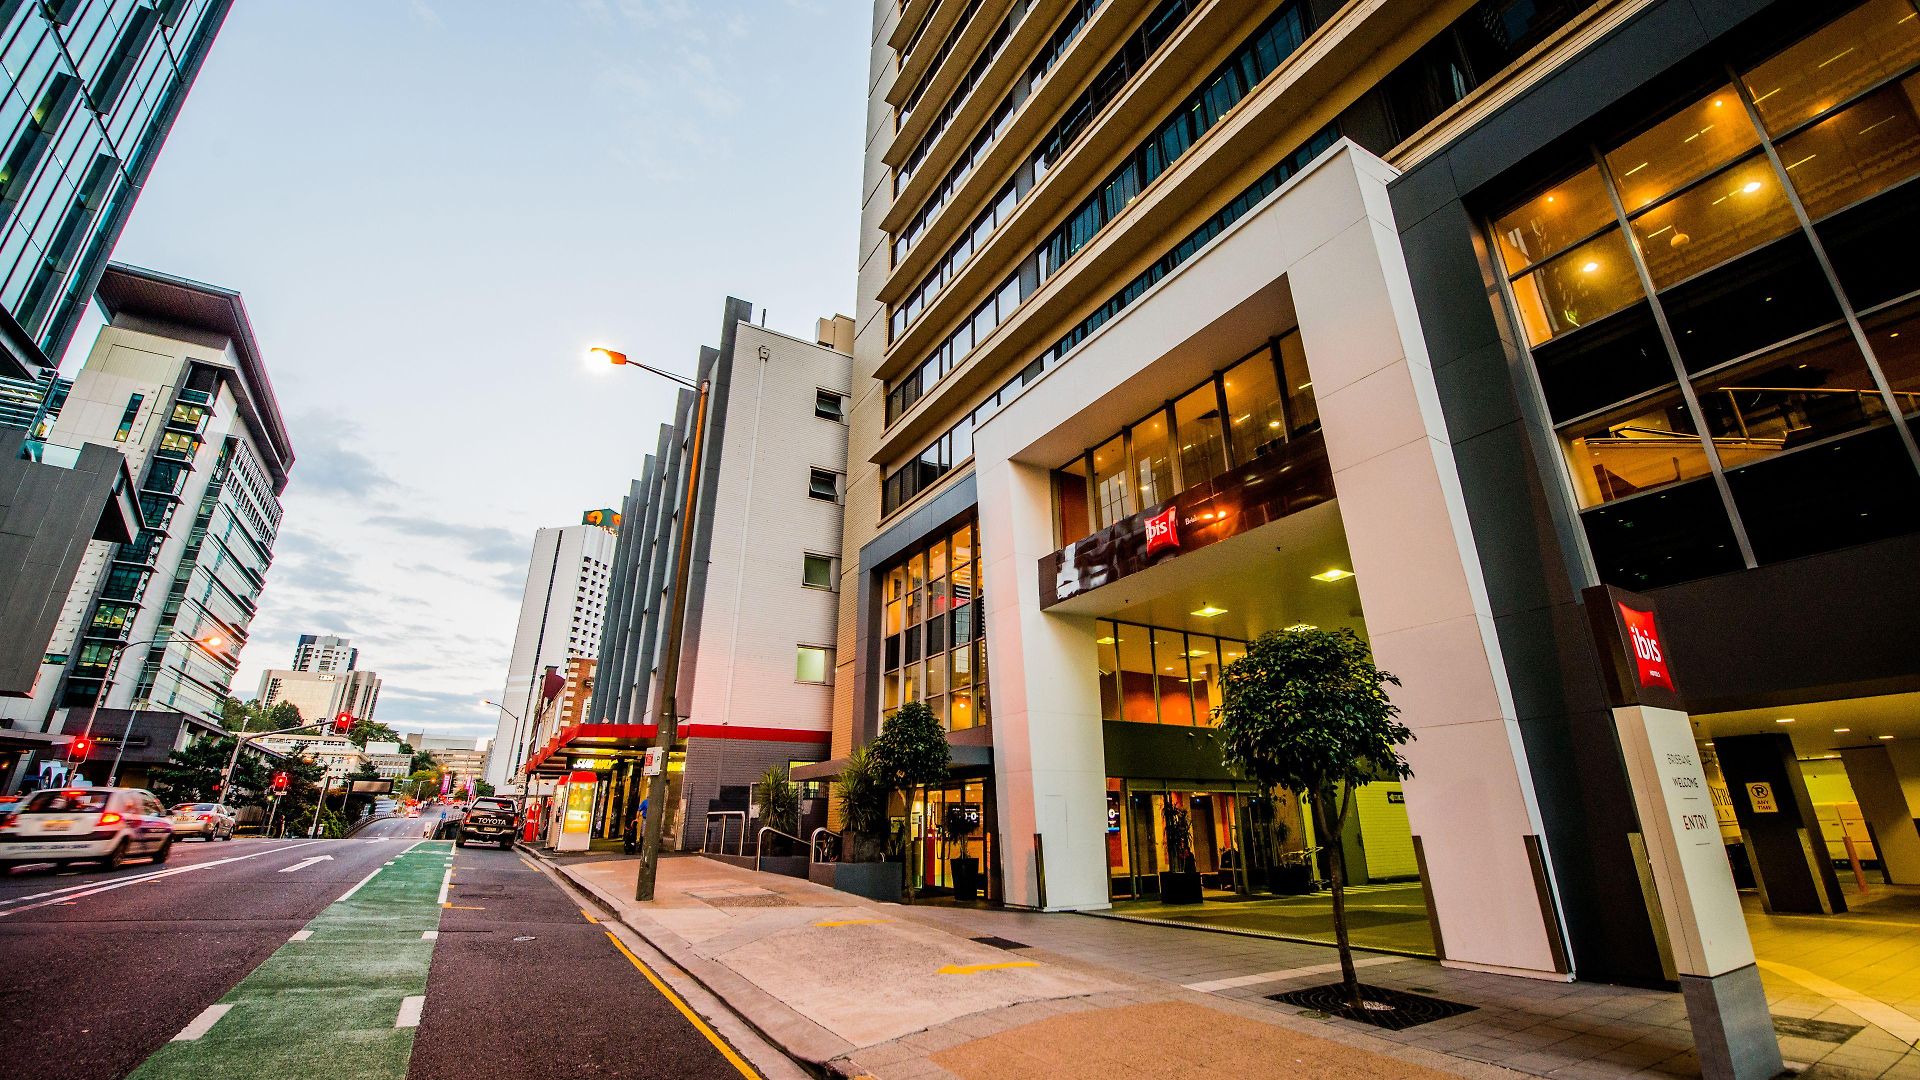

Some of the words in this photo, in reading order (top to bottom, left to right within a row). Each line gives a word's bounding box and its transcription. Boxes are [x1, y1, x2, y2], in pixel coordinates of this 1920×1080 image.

[1630, 623, 1661, 663] ibis
[1672, 777, 1699, 789] WELCOME
[478, 817, 507, 826] TOYOTA
[1682, 814, 1709, 831] ENTRY
